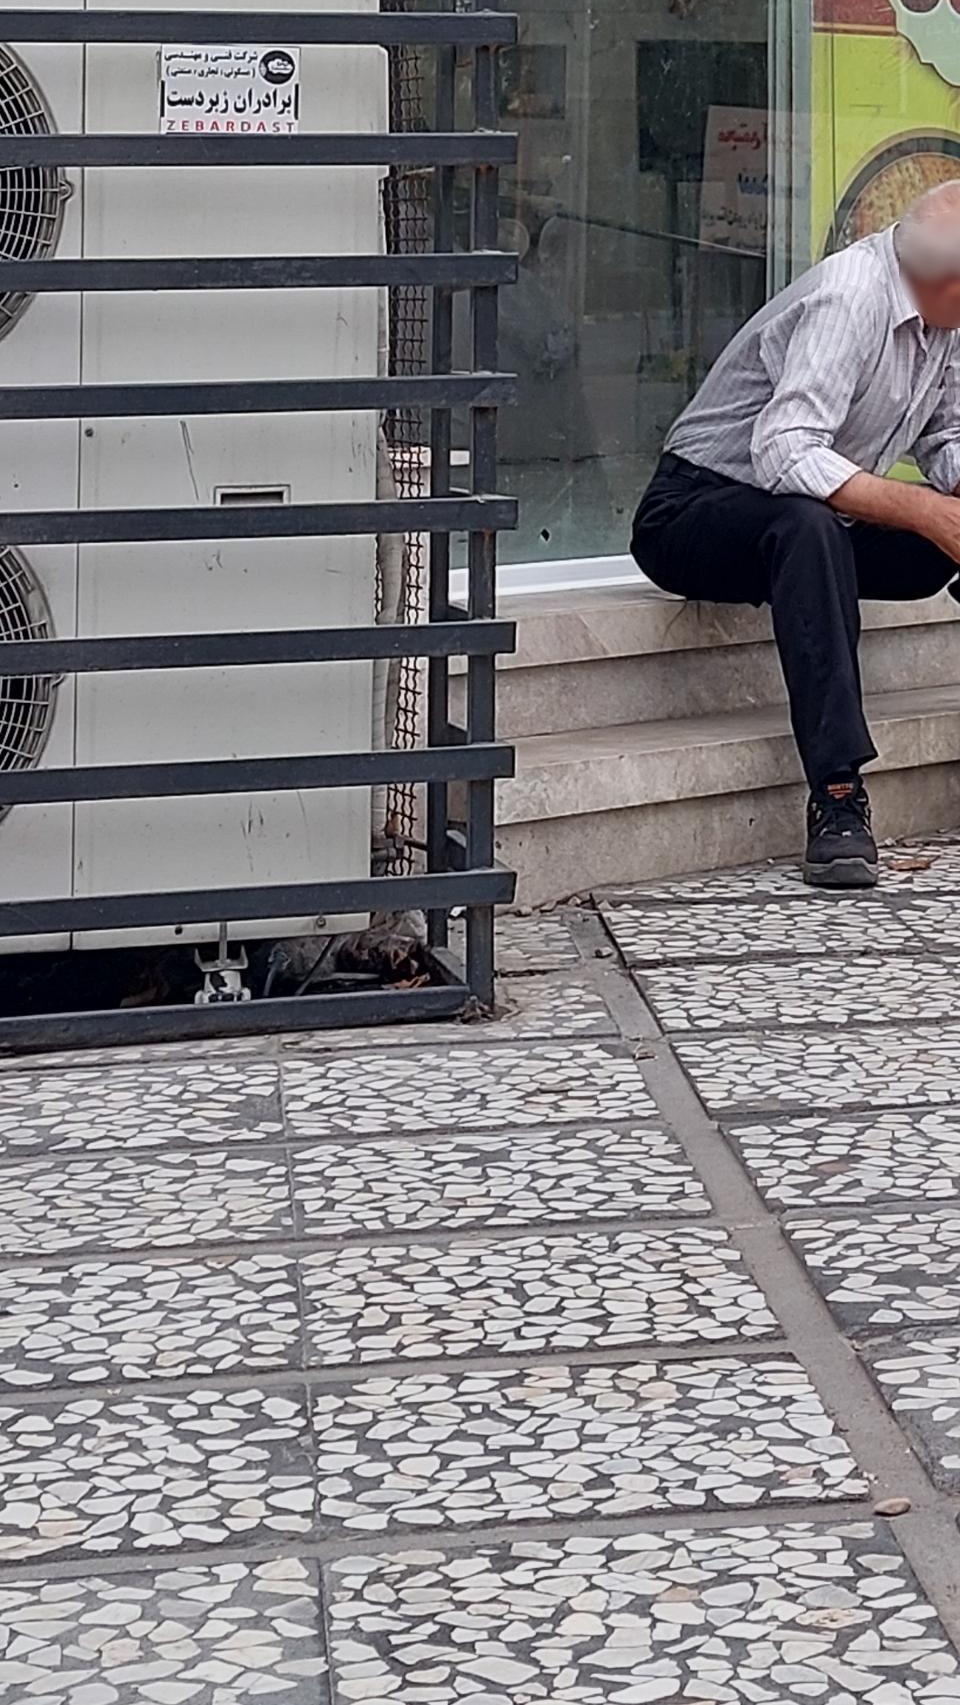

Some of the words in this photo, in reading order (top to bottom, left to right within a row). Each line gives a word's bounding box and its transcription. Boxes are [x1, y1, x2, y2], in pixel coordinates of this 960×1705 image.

[164, 50, 202, 62] مهندسی
[203, 52, 209, 63] و
[210, 49, 232, 63] فنی
[233, 50, 258, 64] شرکت
[166, 90, 229, 114] زبردست
[233, 88, 292, 115] برادران
[166, 119, 295, 132] ZEBARDAST
